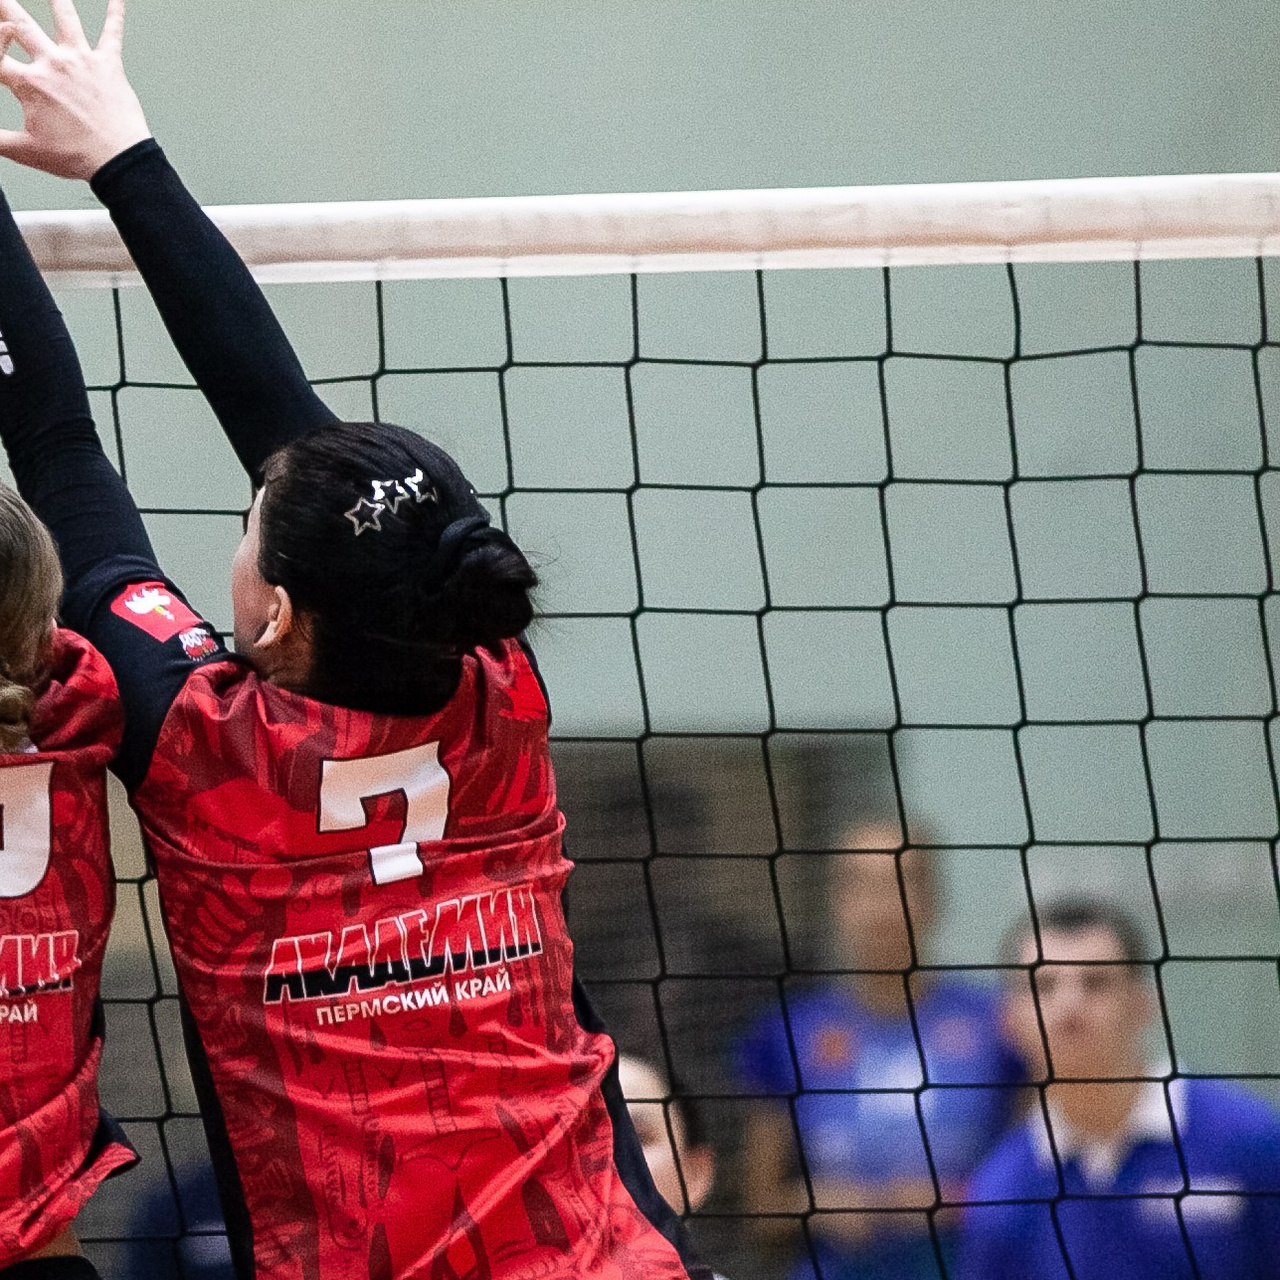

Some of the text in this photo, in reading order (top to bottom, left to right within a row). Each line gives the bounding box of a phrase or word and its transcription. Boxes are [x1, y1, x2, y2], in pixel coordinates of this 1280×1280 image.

[317, 739, 451, 886] 7
[262, 882, 544, 1005] АКАДЕМИЯ
[315, 967, 512, 1026] ПЕРМСКИЙ КРАЙ
